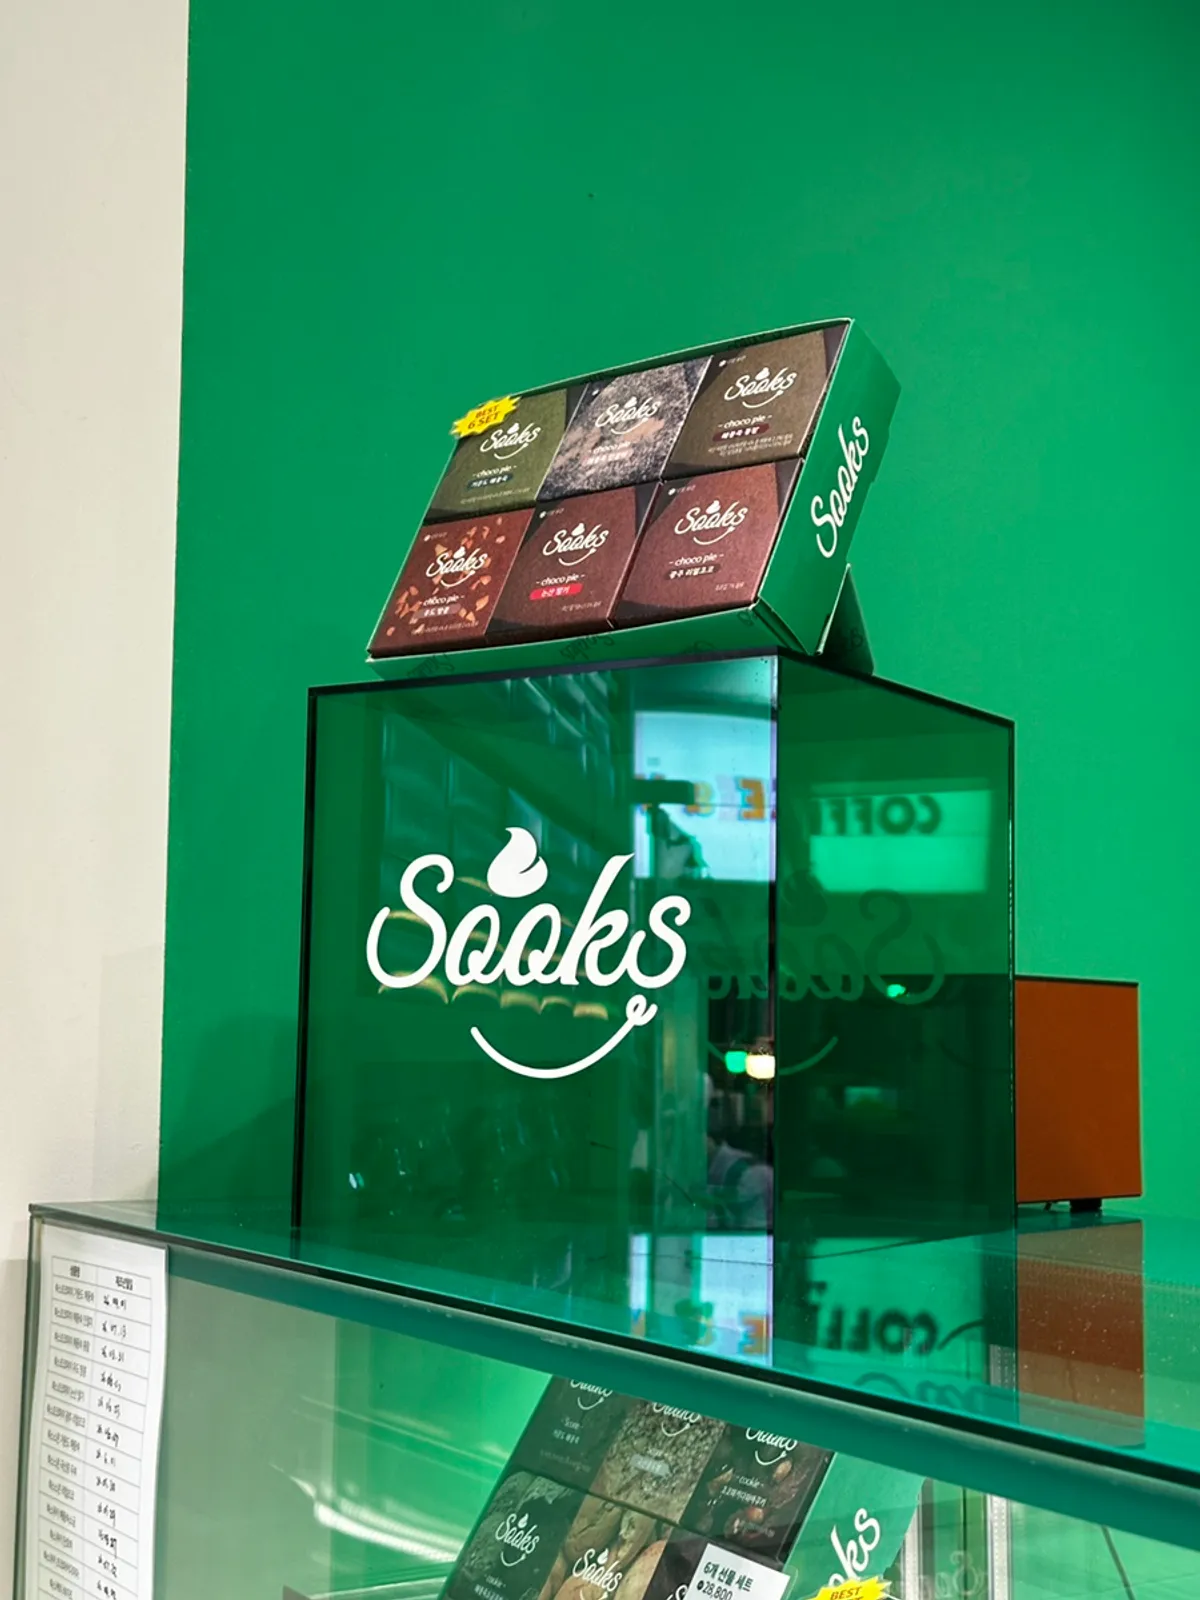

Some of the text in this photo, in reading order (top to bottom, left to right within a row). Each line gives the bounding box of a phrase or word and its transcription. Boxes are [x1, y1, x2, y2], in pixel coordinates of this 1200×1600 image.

[476, 404, 499, 418] BEST
[468, 412, 498, 429] 6 SET
[724, 415, 766, 429] choco pie
[476, 465, 512, 478] choco pie
[674, 553, 717, 566] choco pie
[541, 574, 579, 586] choco pie
[423, 594, 459, 606] choco pie
[703, 1561, 754, 1593] 6개 선물 세트
[702, 1582, 733, 1600] 28,800
[830, 1586, 863, 1600] BEST
